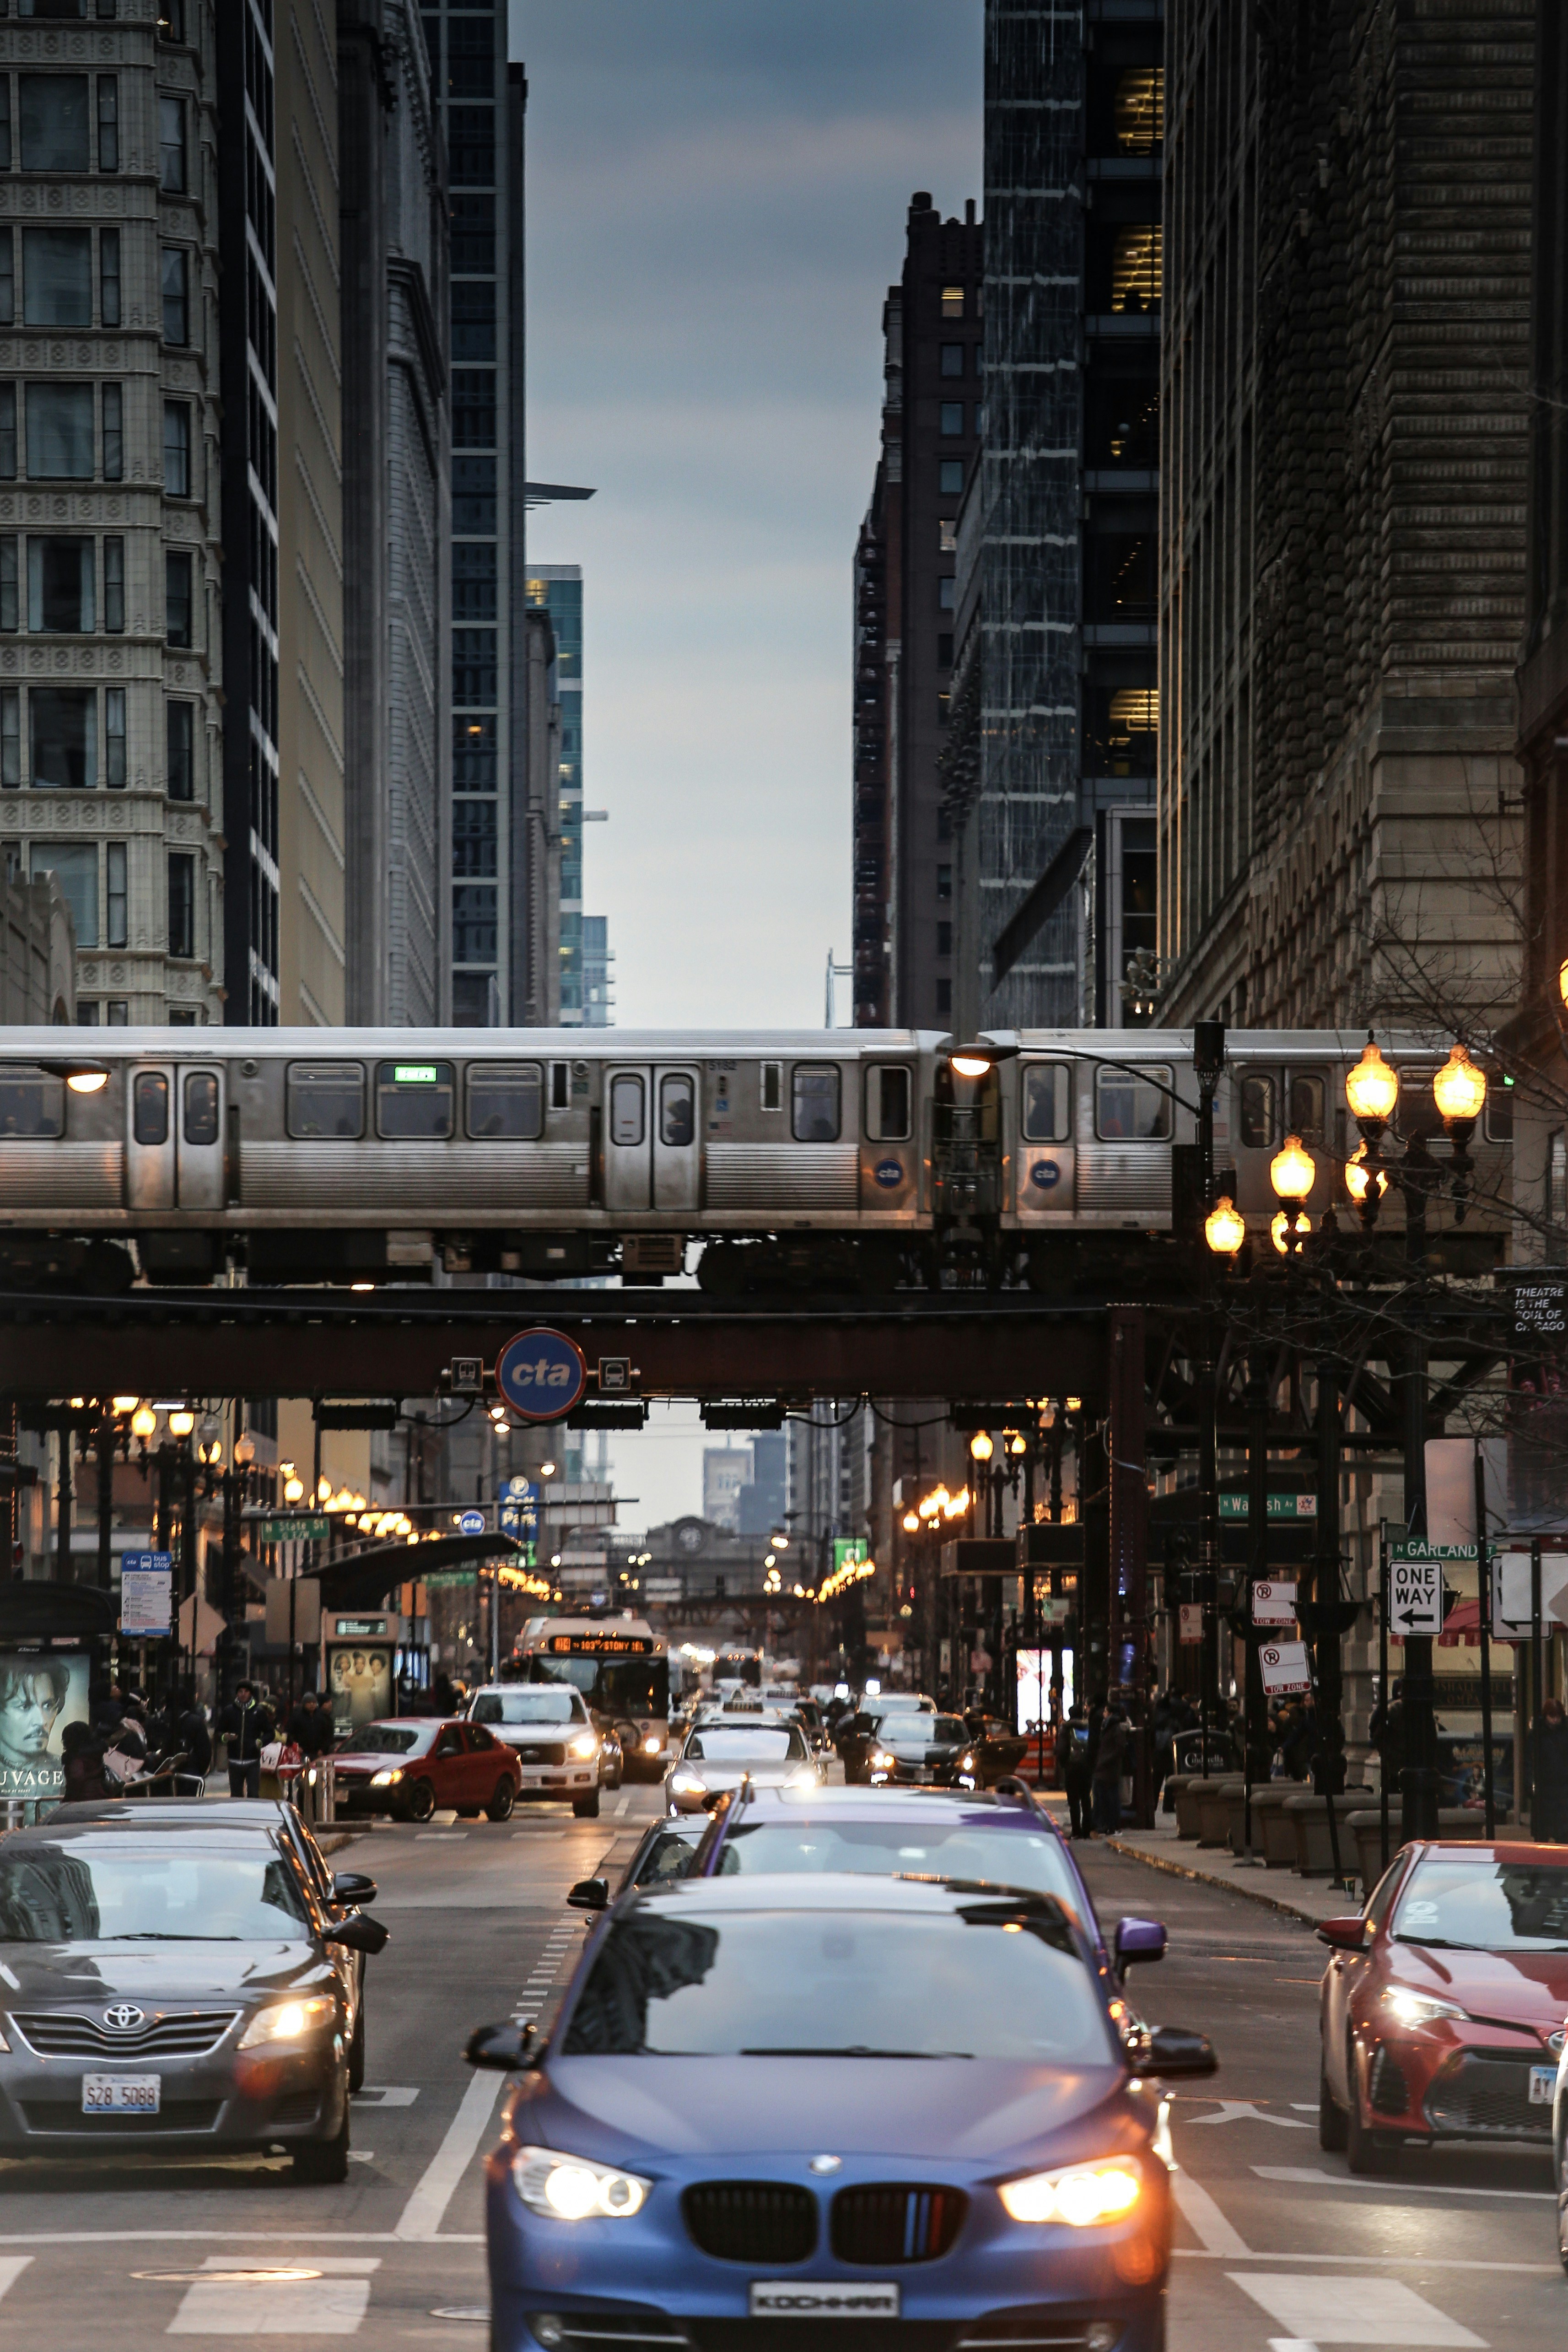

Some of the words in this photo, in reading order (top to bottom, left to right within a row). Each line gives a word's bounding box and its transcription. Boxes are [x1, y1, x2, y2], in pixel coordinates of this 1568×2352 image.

[1515, 1288, 1564, 1297] THEATRE
[1529, 1299, 1550, 1308] HE
[1516, 1310, 1544, 1320] OUL
[1546, 1310, 1562, 1319] OF
[512, 1359, 571, 1386] cta
[1232, 1497, 1281, 1511] Wash
[279, 1520, 306, 1531] State
[463, 1518, 482, 1529] cta
[1397, 1544, 1403, 1553] N
[1408, 1541, 1478, 1557] GARLAND
[154, 1561, 170, 1570] stop
[1396, 1567, 1435, 1585] ONE
[1396, 1587, 1435, 1605] WAY
[1287, 1682, 1305, 1692] ZONE
